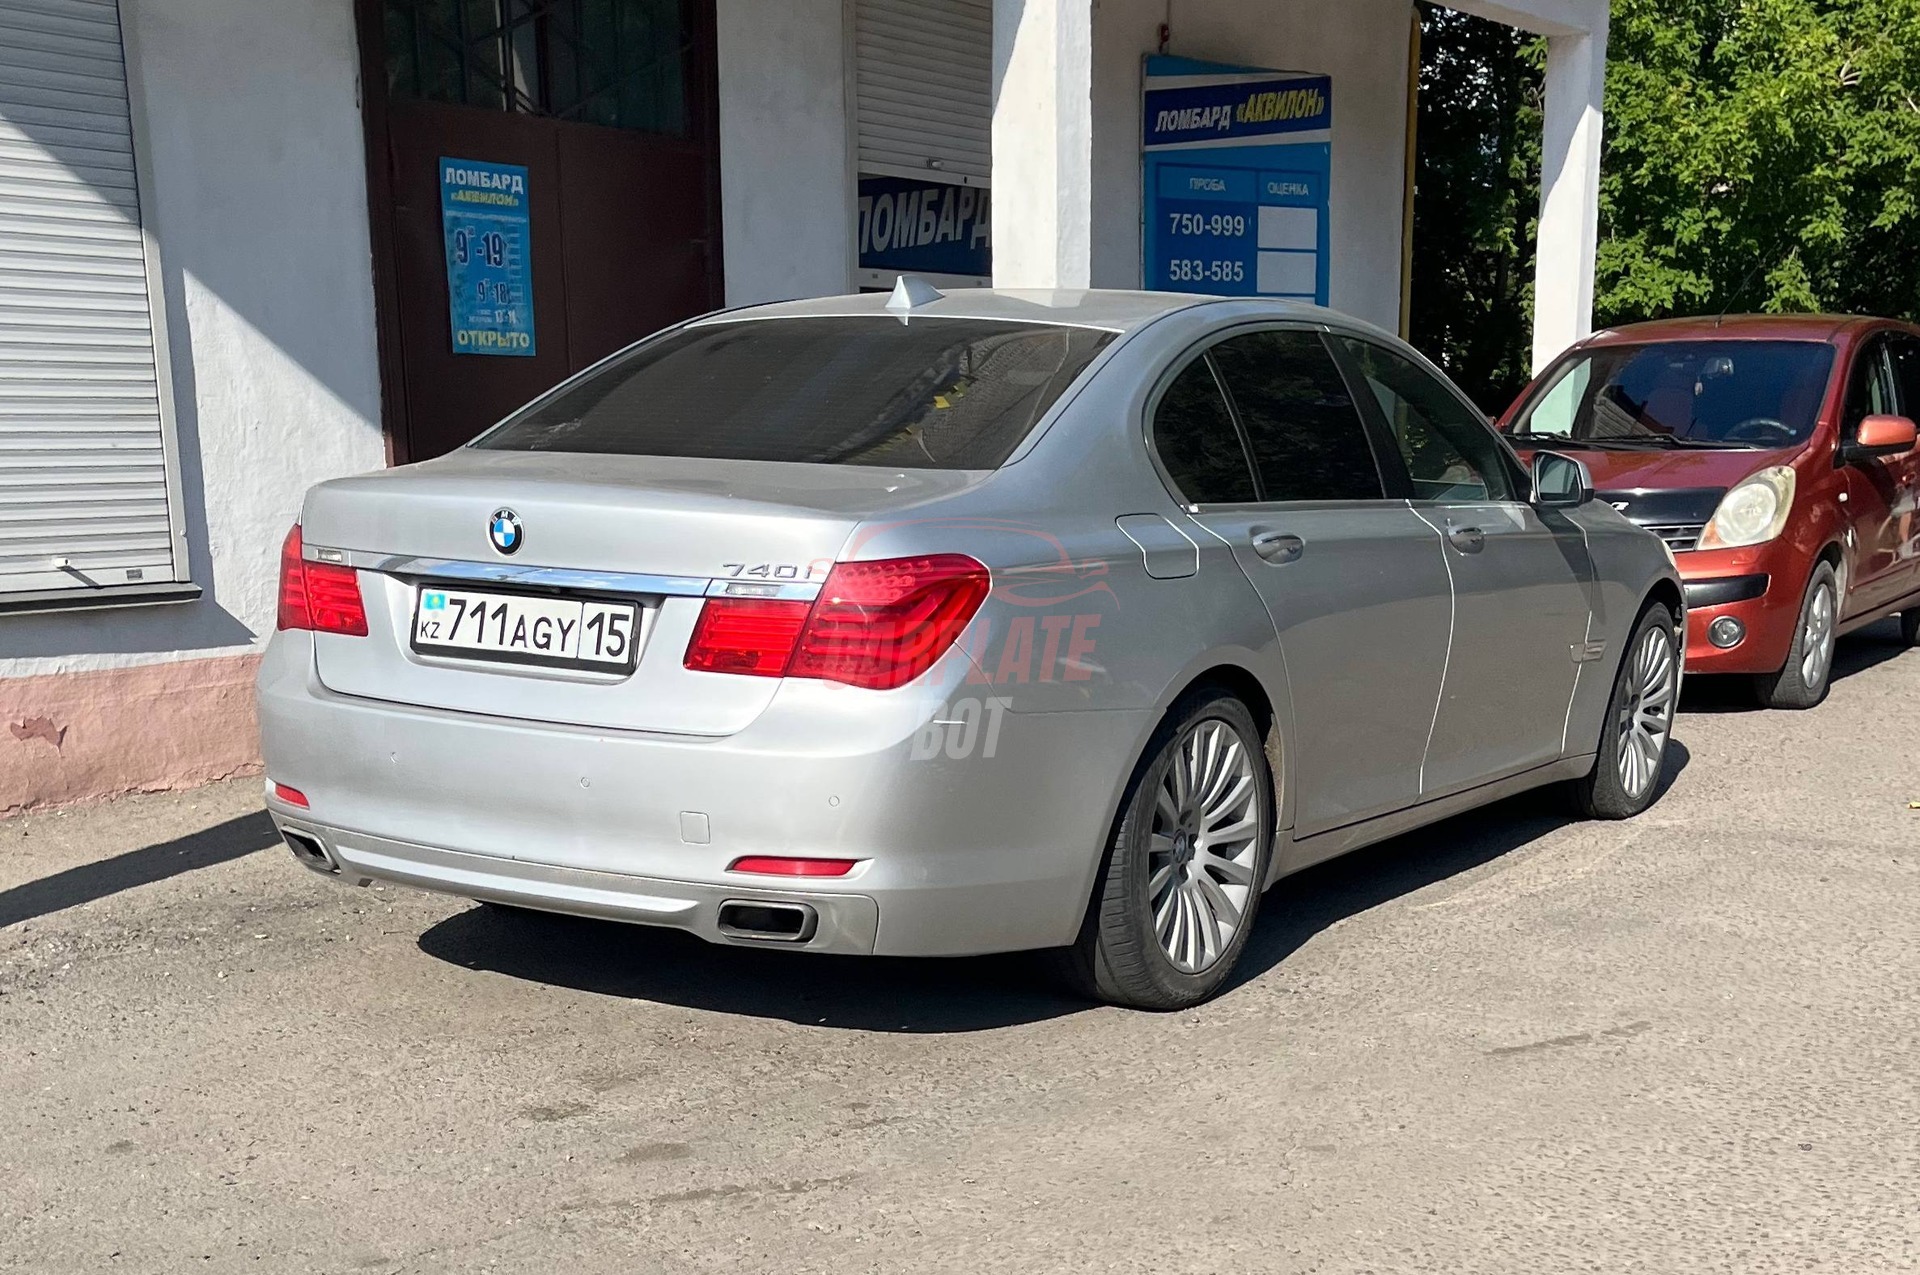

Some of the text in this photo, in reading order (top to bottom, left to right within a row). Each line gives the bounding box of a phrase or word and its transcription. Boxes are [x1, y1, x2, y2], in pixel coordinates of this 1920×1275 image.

[1155, 88, 1325, 132] ЛОМБАРД «АКВИЛОН»
[445, 167, 524, 194] ЛОМБАРД
[1189, 177, 1309, 196] ПРОБА ОЦЕНКА
[1169, 213, 1245, 237] 750-999
[1169, 260, 1244, 282] 583-585
[458, 330, 530, 348] ОТКРЫТО
[722, 563, 813, 579] 740i
[420, 621, 441, 639] KZ
[586, 612, 630, 657] 15
